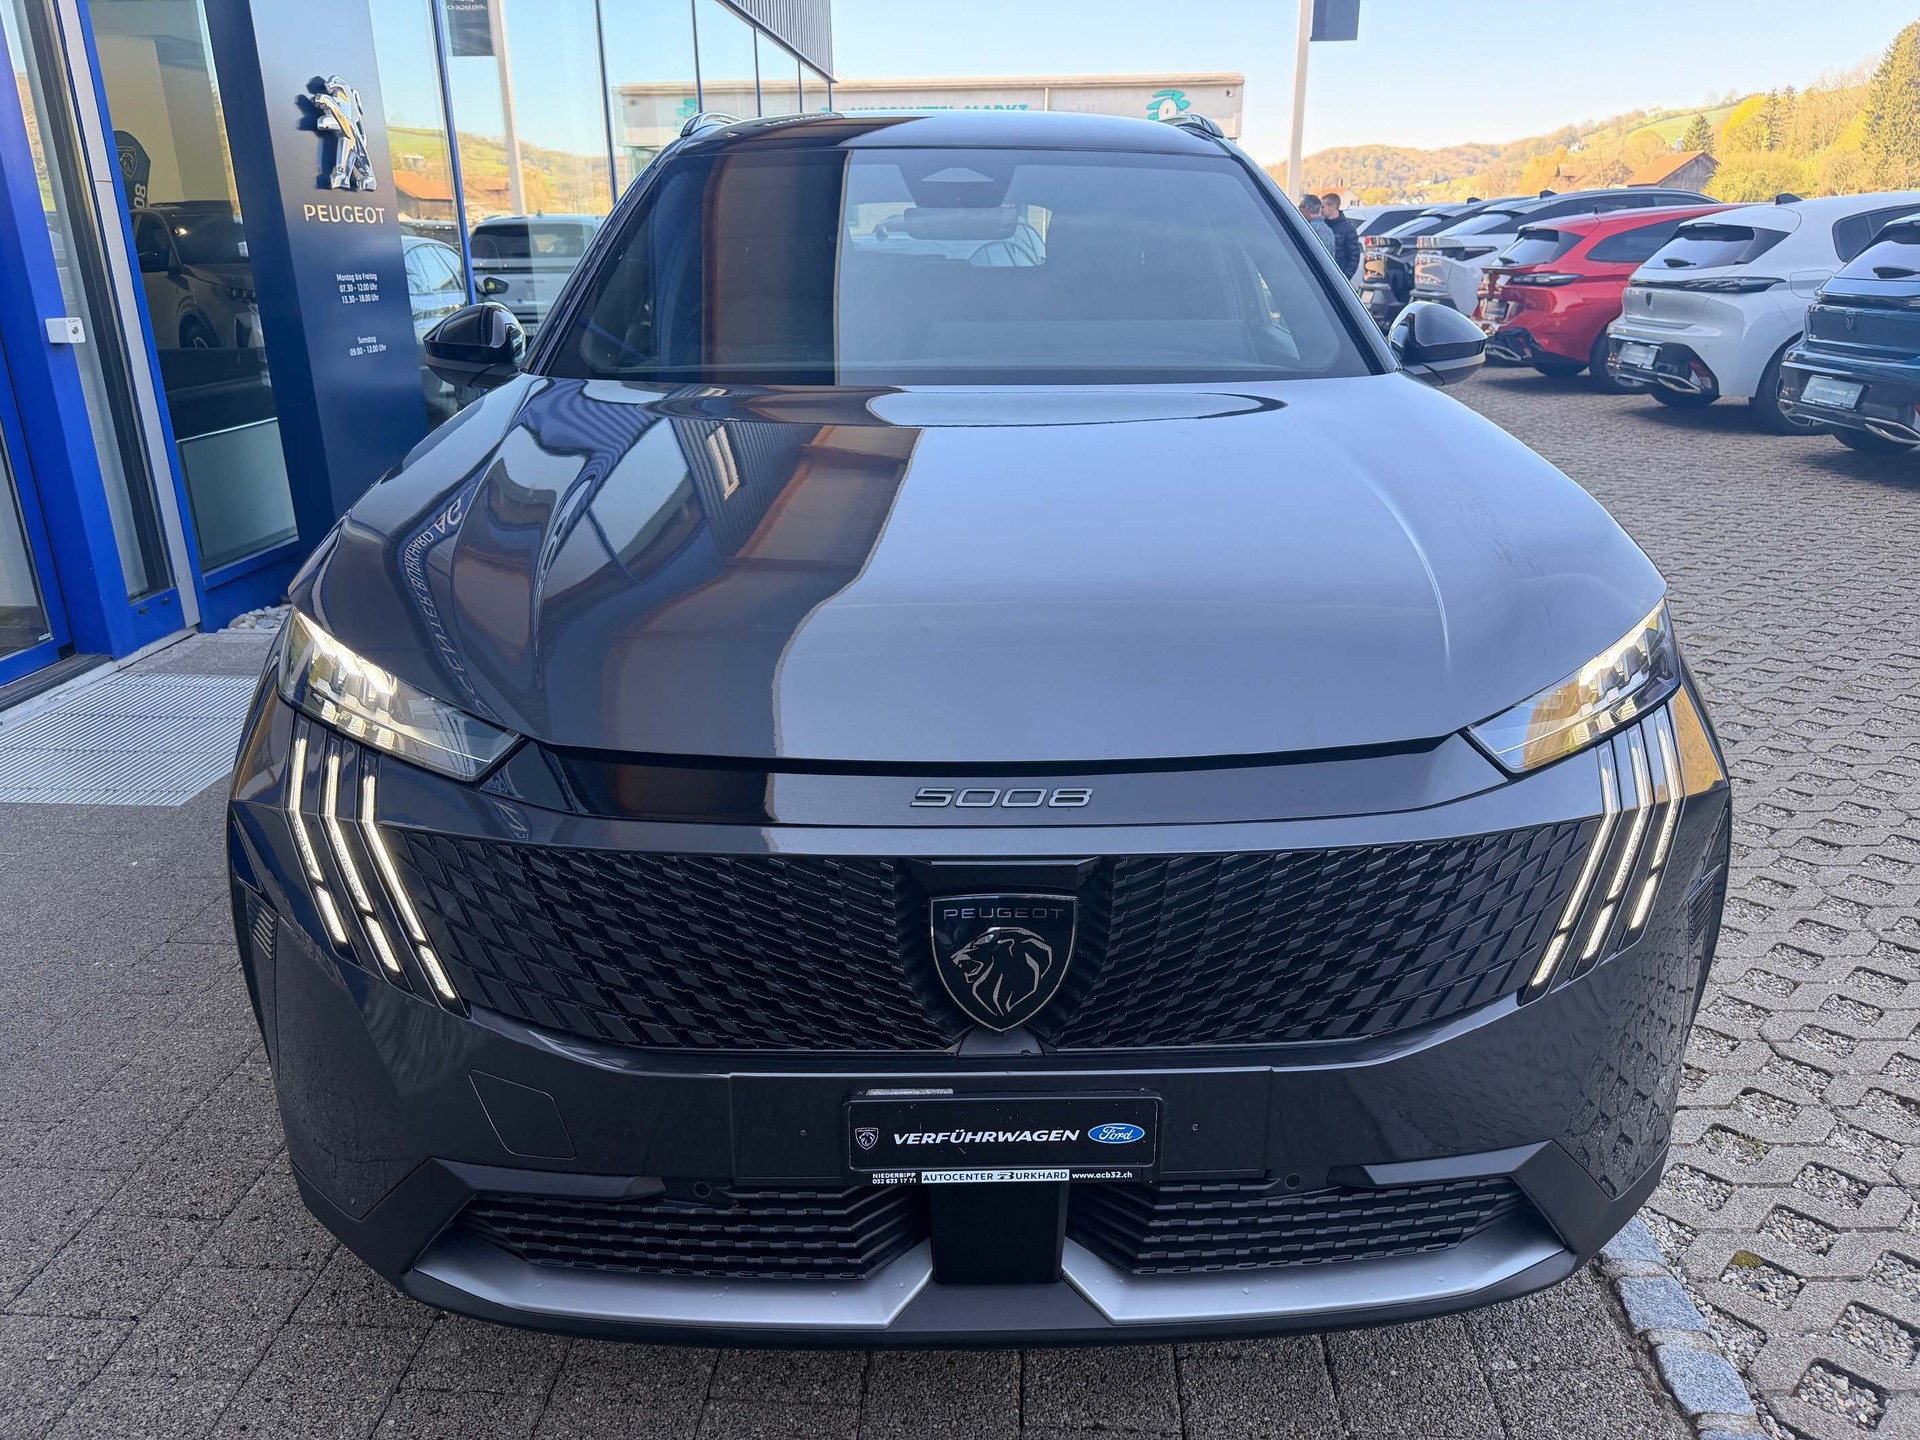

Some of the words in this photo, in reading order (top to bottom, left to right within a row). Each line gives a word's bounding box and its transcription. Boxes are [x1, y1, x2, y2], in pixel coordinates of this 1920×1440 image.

[303, 204, 386, 224] PEUGEOT
[336, 273, 354, 282] Montag
[354, 273, 362, 281] bis
[362, 272, 378, 281] Freitag
[339, 284, 353, 293] 07.30
[369, 282, 378, 291] Uhr
[371, 293, 379, 302] Uhr
[357, 336, 377, 344] Samstag
[379, 343, 387, 351] Uhr
[910, 787, 1094, 808] 5008
[943, 907, 1064, 920] PEUGEOT
[893, 1129, 1081, 1145] VERFÜHRWAGEN
[923, 1173, 994, 1182] AUTOCENTER
[998, 1171, 1068, 1181] BURKHARD
[1071, 1171, 1133, 1179] www.acb32.ch
